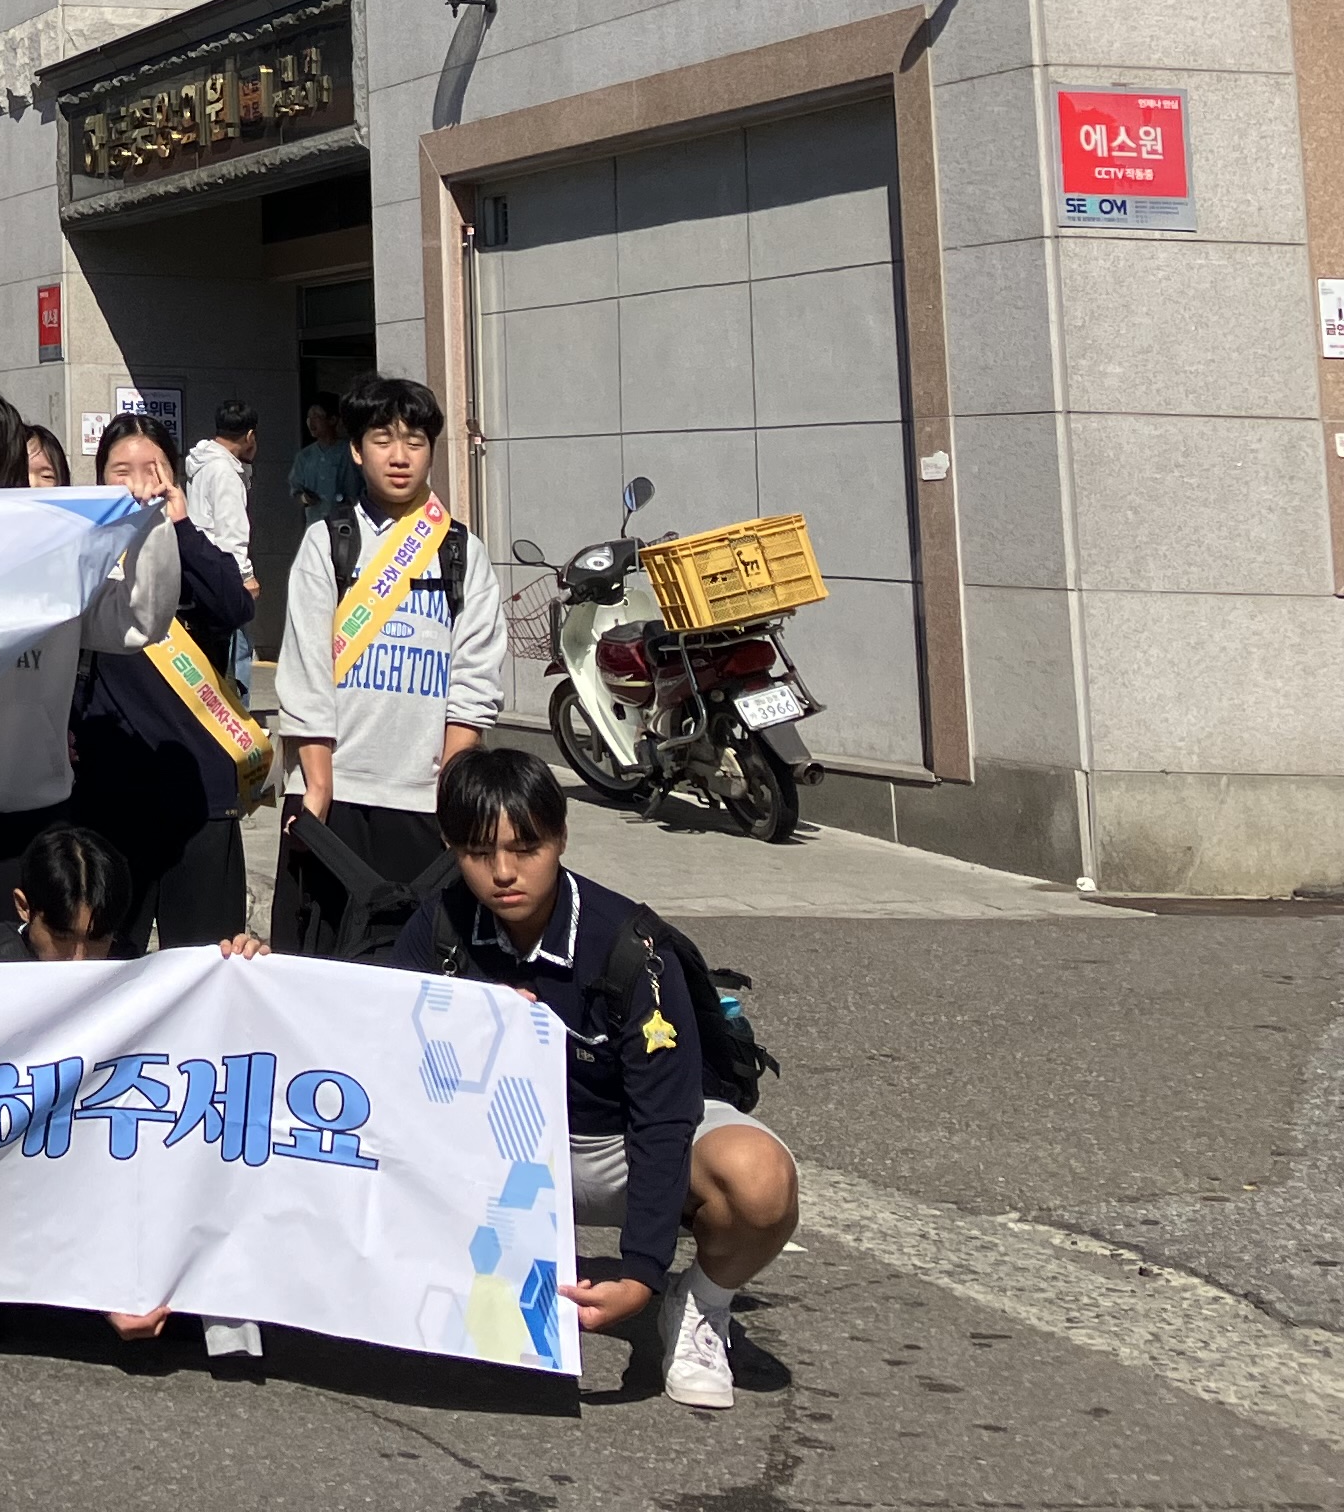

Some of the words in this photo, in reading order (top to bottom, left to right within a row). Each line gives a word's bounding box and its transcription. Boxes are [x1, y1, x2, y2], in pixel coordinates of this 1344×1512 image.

[1079, 123, 1165, 160] 에스원
[1094, 166, 1124, 179] CCTV
[1125, 167, 1154, 181] 작동중
[1066, 197, 1128, 215] SEOM
[371, 565, 402, 599] 주차
[341, 605, 372, 639] 마을
[382, 621, 413, 637] ONDON
[758, 699, 795, 720] 3966
